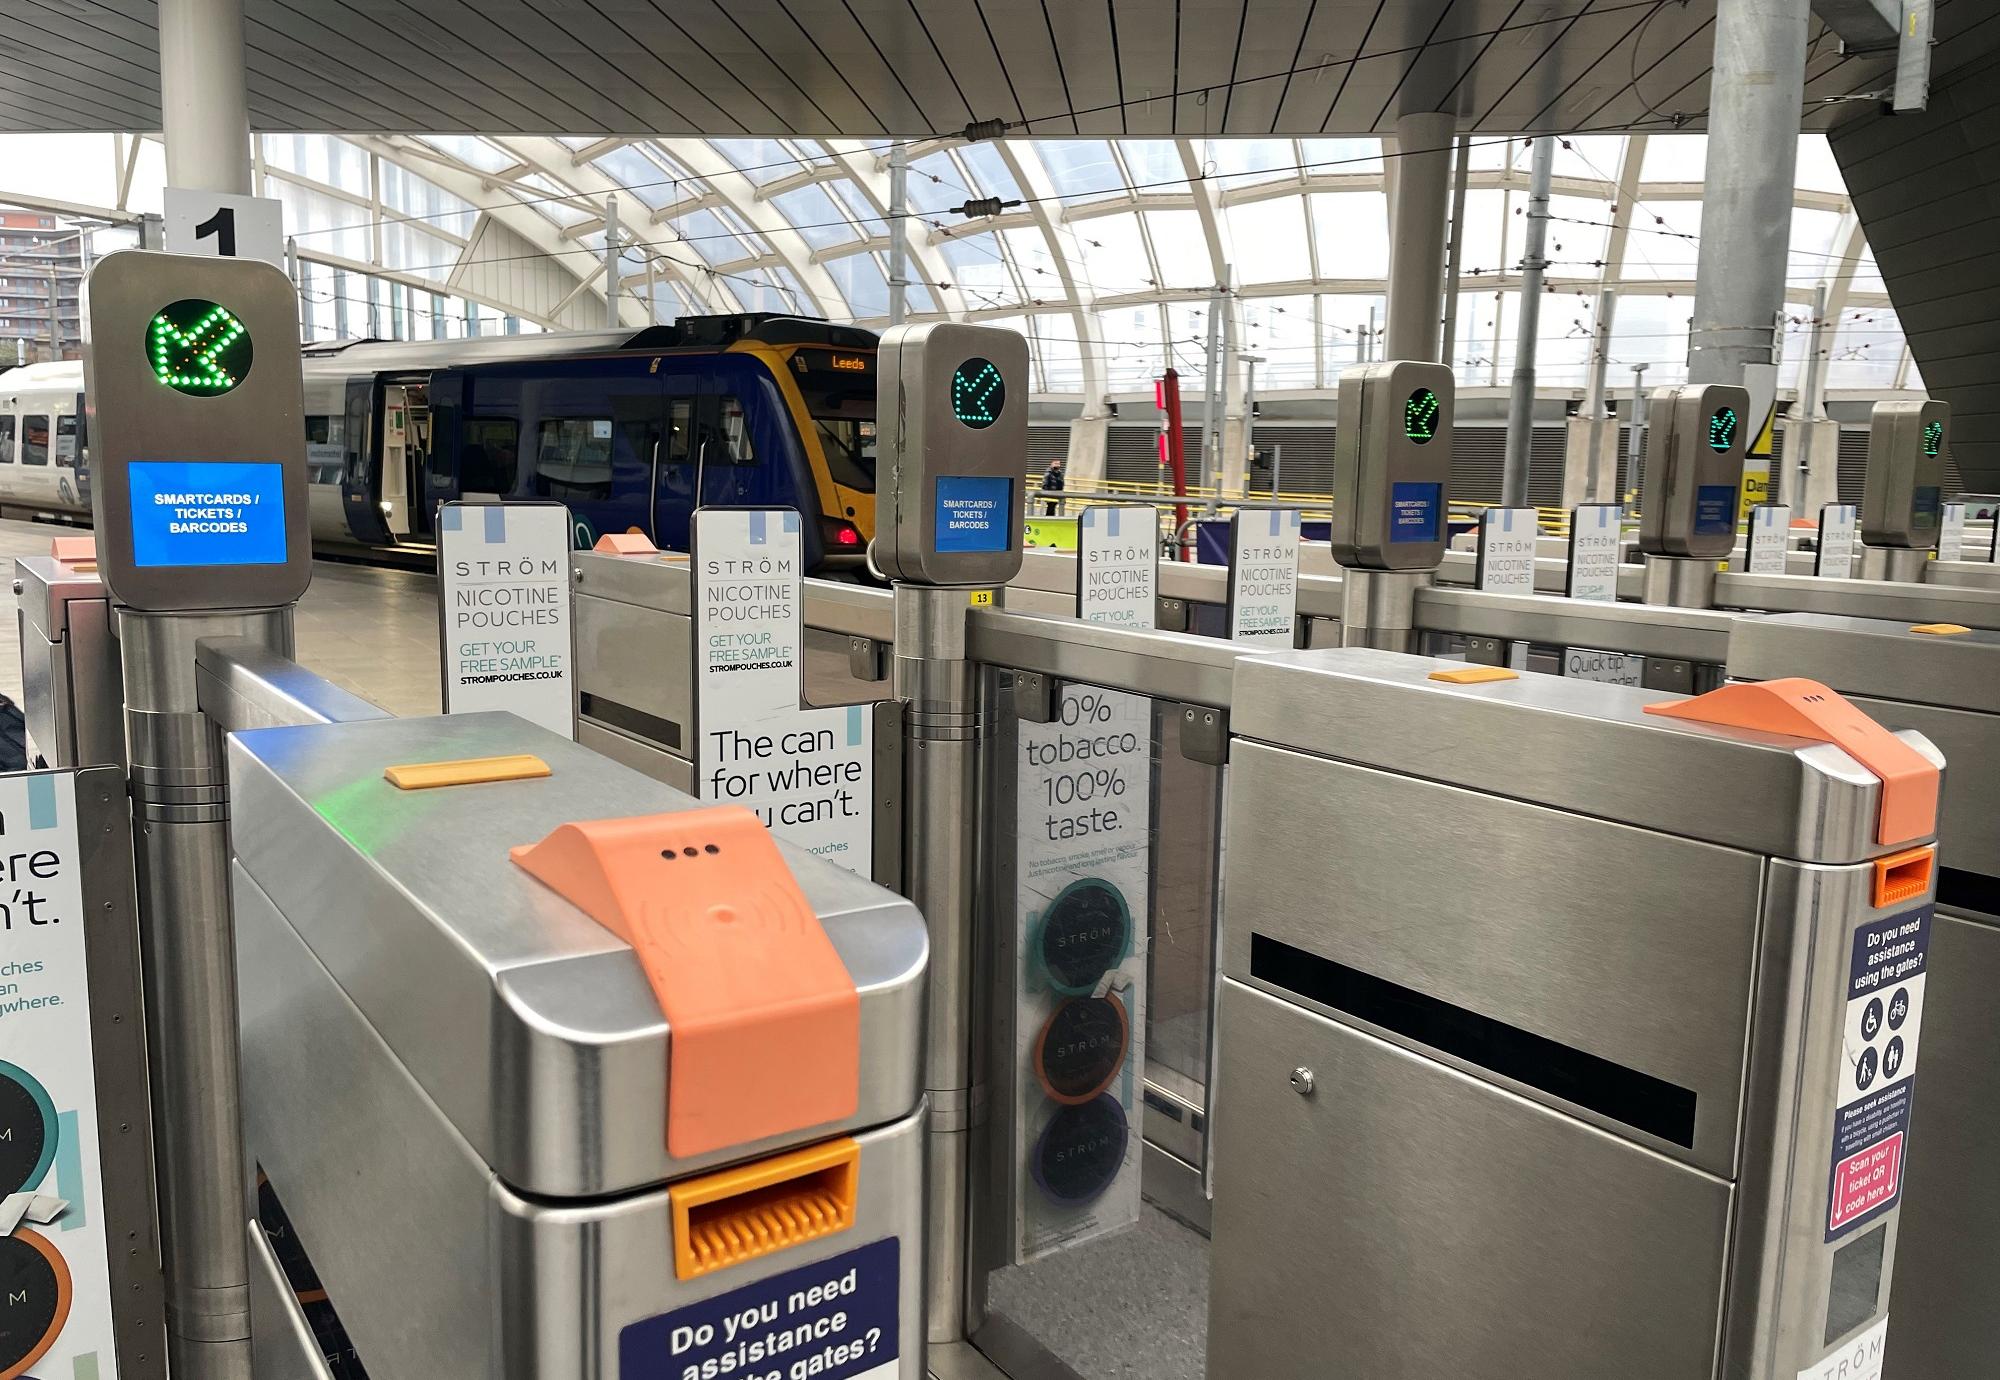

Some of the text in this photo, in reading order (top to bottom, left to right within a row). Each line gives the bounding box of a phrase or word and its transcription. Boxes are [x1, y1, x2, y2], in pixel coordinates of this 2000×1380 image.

[196, 207, 236, 256] 1
[832, 355, 865, 370] Leeds
[154, 493, 252, 505] SMARTCARDS
[943, 500, 993, 508] SMARTCARDS
[174, 508, 234, 519] TICKETS
[169, 522, 248, 533] BARCODES
[949, 521, 989, 529] BARCODES
[1489, 540, 1532, 553] STRÖM
[1578, 536, 1616, 548] STRÖM
[1089, 546, 1149, 563] STRÖM
[1242, 546, 1293, 560] STRÖM
[1577, 553, 1615, 565] NICOTINE
[456, 556, 557, 577] STRÖM
[708, 556, 790, 575] STRÖM
[1241, 567, 1293, 581] NICOTINE
[1488, 559, 1531, 572] NICOTINE
[1576, 567, 1614, 578] POUCHES
[1089, 569, 1150, 586] NICOTINE
[1487, 573, 1530, 585] POUCHES
[457, 587, 559, 607] NICOTINE
[708, 584, 791, 602] NICOTINE
[977, 593, 988, 603] 13
[1089, 586, 1149, 601] POUCHES
[1240, 583, 1292, 596] POUCHES
[458, 608, 559, 629] POUCHES
[708, 604, 791, 622] POUCHES
[1108, 609, 1135, 621] YOUR
[1239, 605, 1279, 617] GET YOUR
[1239, 618, 1258, 628] FREE
[460, 640, 536, 656] GET YOUR
[709, 632, 772, 647] GET YOUR
[709, 648, 740, 662] FREE
[1569, 653, 1605, 674] Quick
[460, 658, 497, 674] FREE
[709, 660, 793, 673] STROMPOUCHES.CO.UK
[460, 670, 563, 685] STROMPOUCHES.CO.UK
[1061, 694, 1112, 727] 0%
[709, 729, 834, 762] The can
[1026, 732, 1141, 766] tobacco.
[710, 759, 862, 799] for where
[1043, 767, 1126, 807] 100%
[780, 789, 860, 826] can't.
[1045, 807, 1123, 841] taste.
[1057, 927, 1112, 948] STRÖM
[1867, 917, 1921, 948] Do you need
[1867, 940, 1916, 966] assistance
[1854, 952, 1923, 990] using the gates?
[1844, 1085, 1907, 1121] Please seek assistance
[1849, 1145, 1890, 1175] Scan your
[1849, 1164, 1886, 1194] ticket QR
[1845, 1185, 1885, 1214] code here
[671, 1267, 858, 1357] Do you need
[682, 1310, 848, 1380] assistance
[789, 1327, 881, 1380] gates?
